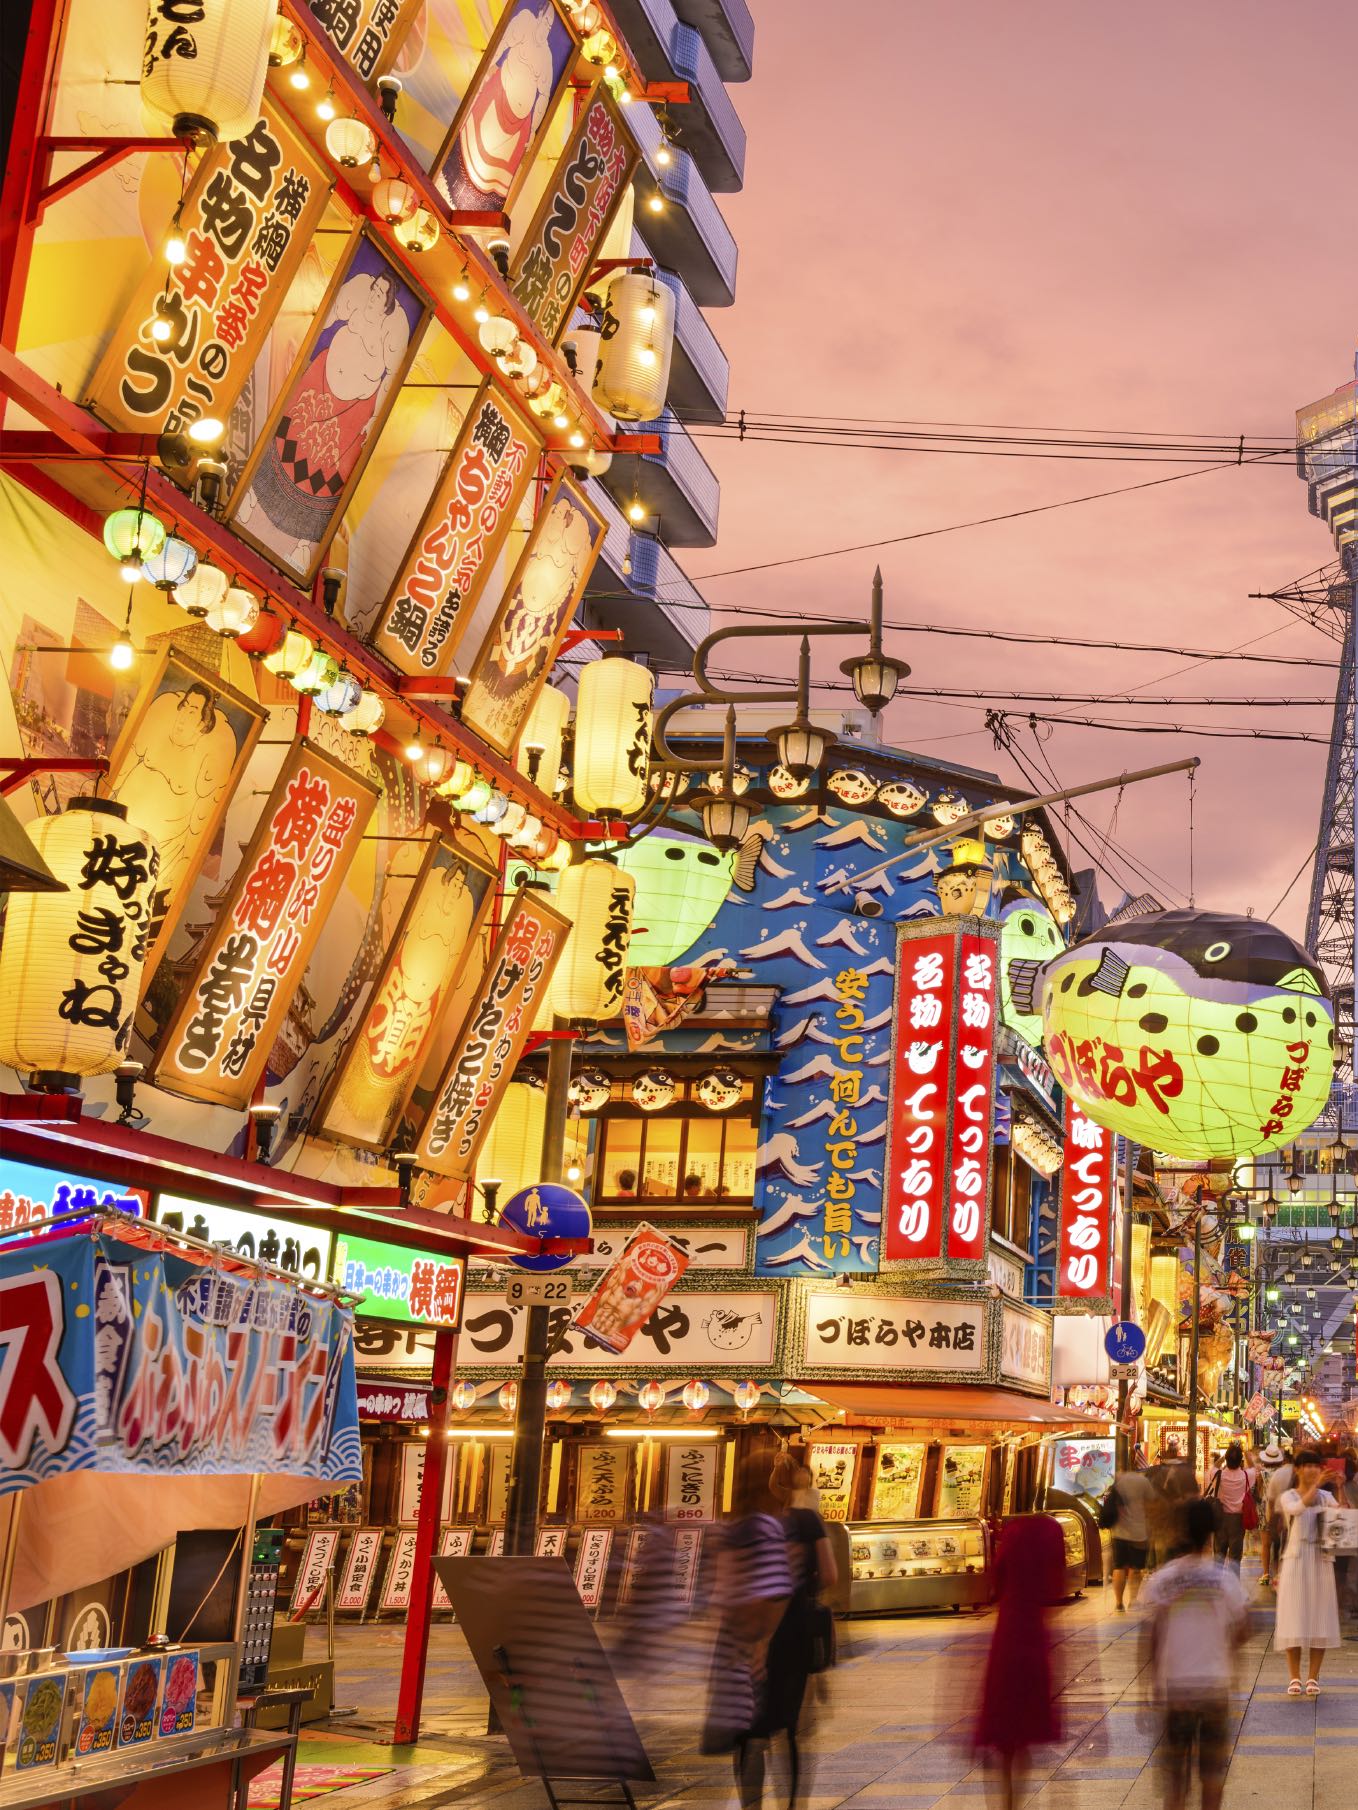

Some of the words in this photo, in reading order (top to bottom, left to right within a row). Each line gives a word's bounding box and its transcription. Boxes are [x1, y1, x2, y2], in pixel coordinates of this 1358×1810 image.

[541, 146, 625, 338] 大阪下町の味
[421, 441, 528, 668] 不動の人気を誇る
[220, 797, 357, 1079] 盛り沢山具材
[911, 952, 945, 1028] 名物
[963, 952, 993, 1029] 名物
[426, 912, 540, 1157] 揚げたこ焼き
[1049, 1030, 1184, 1115] づぼらや
[1259, 1040, 1309, 1140] づぼらや
[899, 1086, 935, 1242] てっちり
[952, 1094, 984, 1241] てっちり
[346, 1262, 409, 1299] 日本一の串かつ
[410, 1260, 459, 1321] 横綱
[512, 1282, 523, 1300] 9
[545, 1281, 567, 1300] 22
[816, 1315, 976, 1351] づぼらや本店
[1111, 1368, 1137, 1377] 9-22
[590, 1451, 616, 1506] ふぐ天ぷら
[680, 1449, 705, 1505] ふぐにぎり
[677, 1509, 703, 1519] 850
[349, 1536, 373, 1592] ふぐ小鍋定食
[394, 1536, 417, 1592] ふぐかつ丼
[582, 1534, 604, 1590] にぎりずし定食
